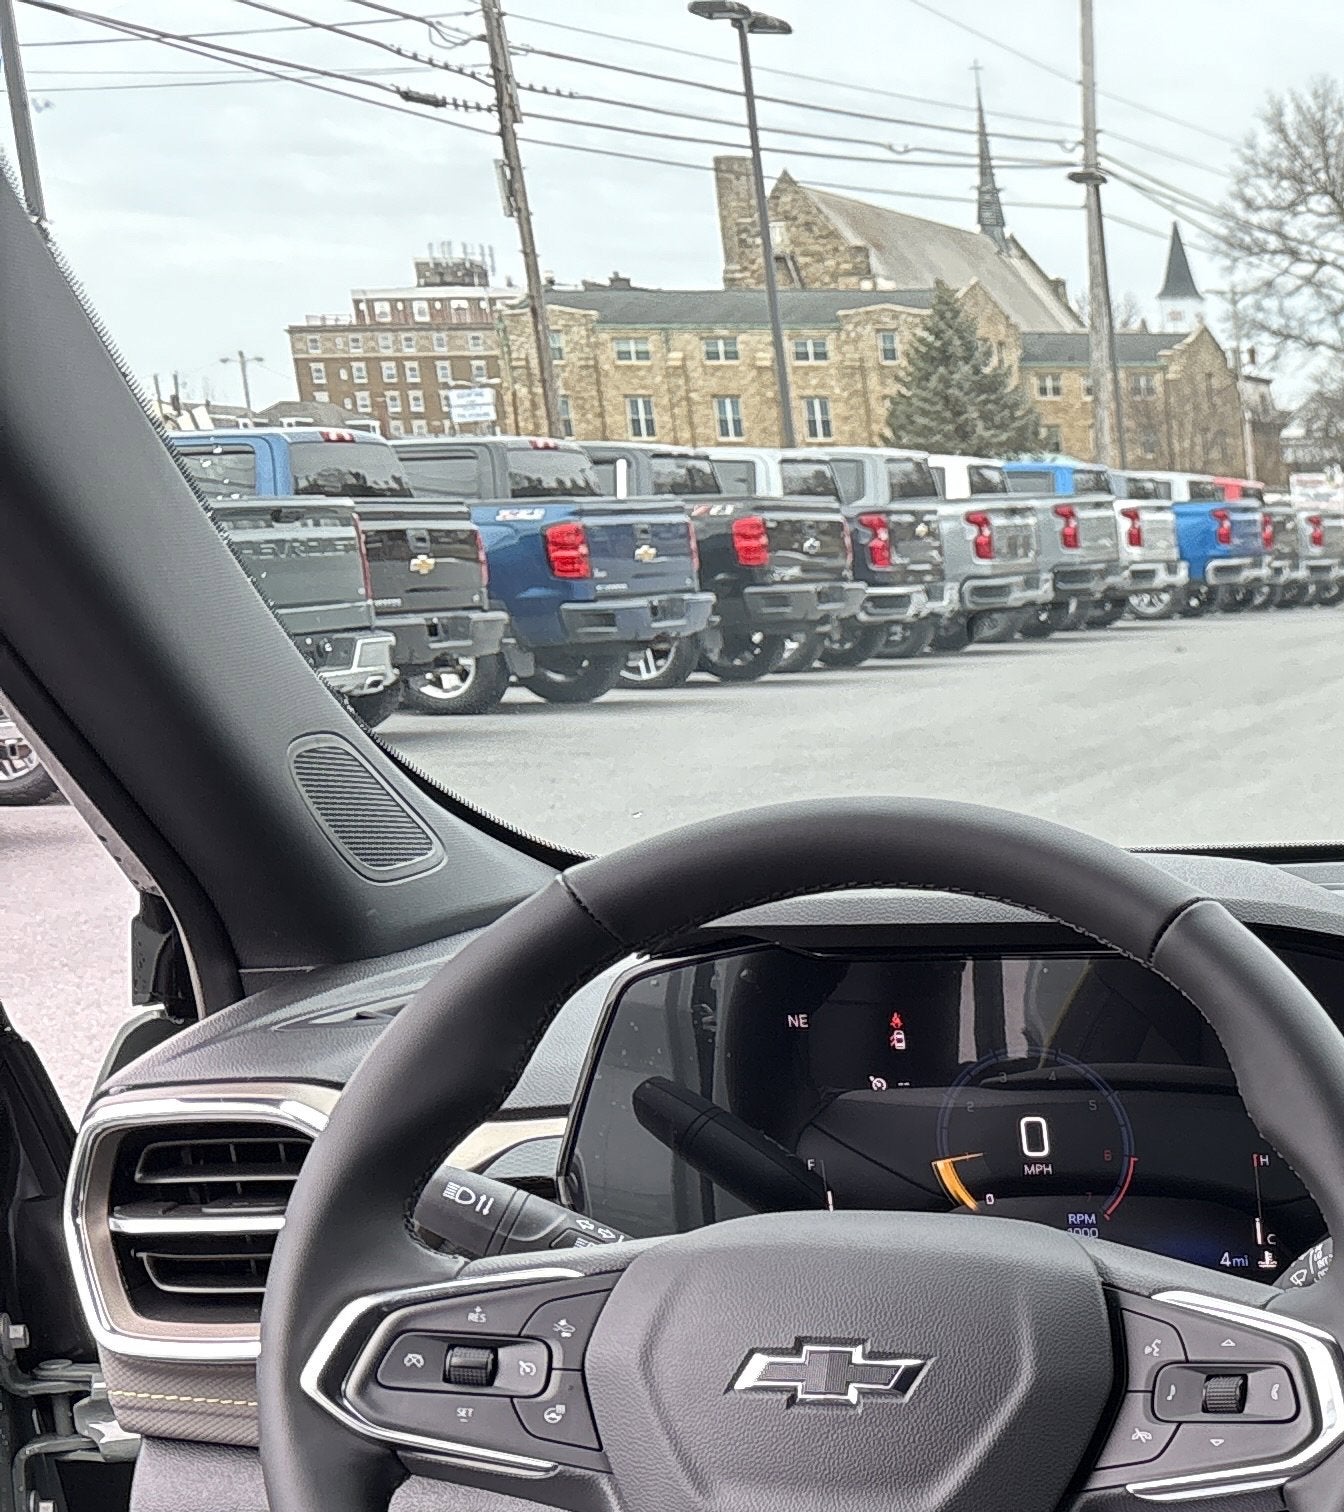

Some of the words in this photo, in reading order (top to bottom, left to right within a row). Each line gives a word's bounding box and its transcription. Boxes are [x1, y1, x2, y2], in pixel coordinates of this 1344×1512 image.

[787, 1013, 809, 1029] NE
[999, 1072, 1008, 1083] 3
[1048, 1071, 1057, 1081] 4
[967, 1101, 975, 1113] 2
[1088, 1100, 1098, 1111] 5
[1020, 1116, 1050, 1157] 0
[807, 1159, 816, 1171] F
[1259, 1155, 1270, 1166] H
[1023, 1163, 1053, 1176] MPH
[1067, 1213, 1097, 1225] RPM
[1266, 1233, 1277, 1246] C
[467, 1311, 487, 1324] RES
[456, 1406, 474, 1418] SET
